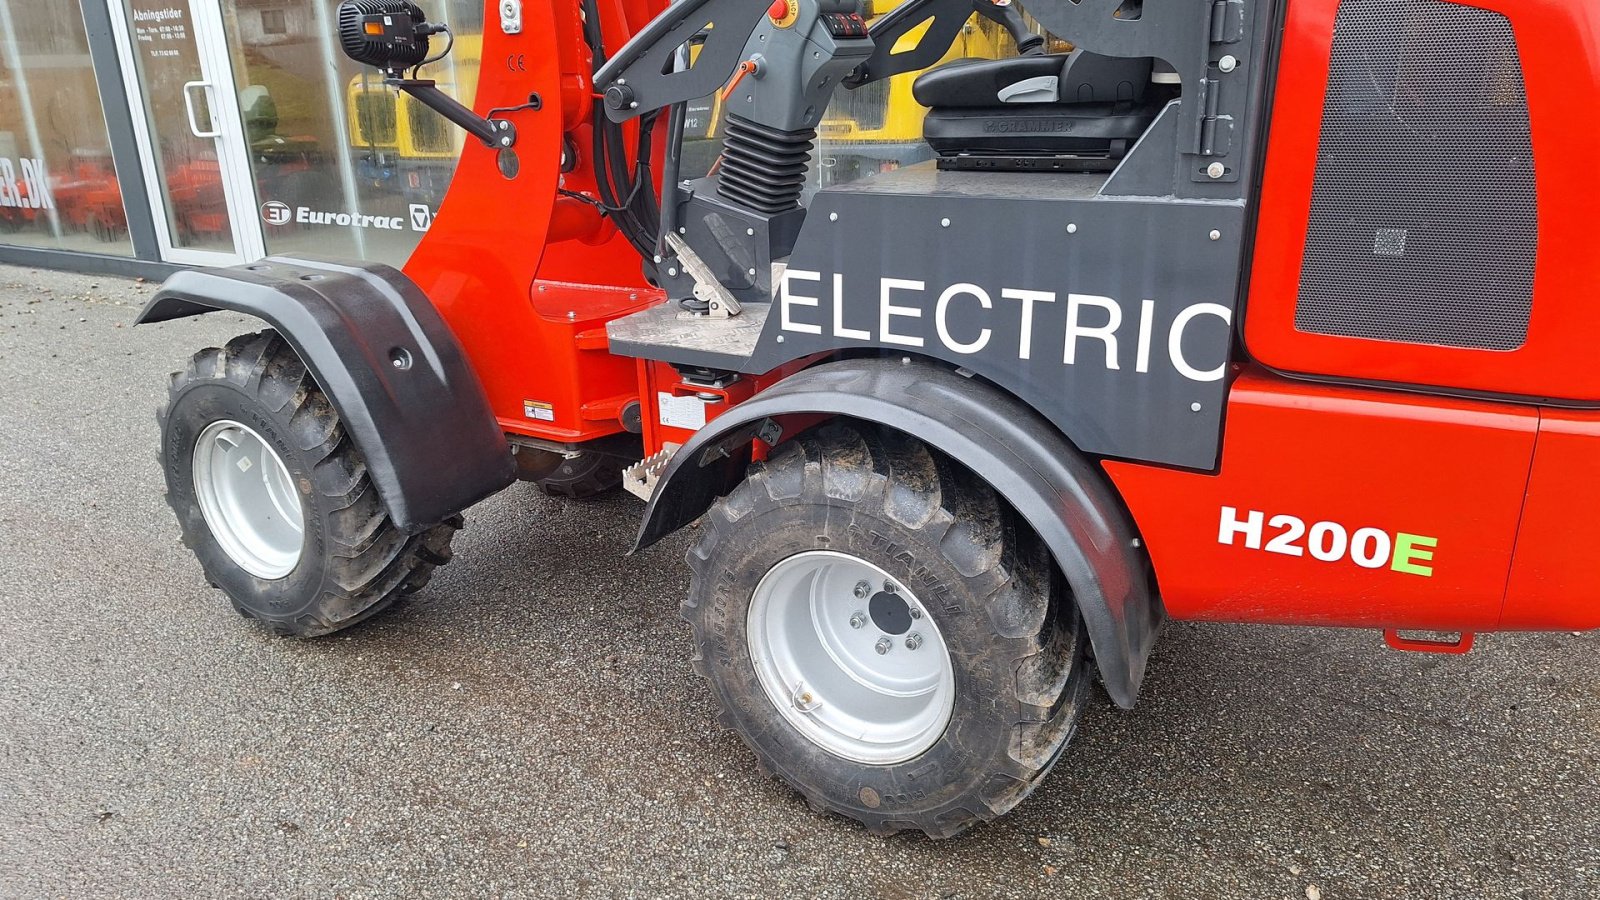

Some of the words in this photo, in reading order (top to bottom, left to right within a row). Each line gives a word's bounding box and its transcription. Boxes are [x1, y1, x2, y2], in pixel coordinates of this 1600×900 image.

[998, 119, 1073, 133] GRAMMER
[296, 206, 403, 230] Eurotrac
[779, 269, 1232, 382] ELECTRIC
[869, 530, 962, 616] TIANLI
[1218, 505, 1438, 577] H200E
